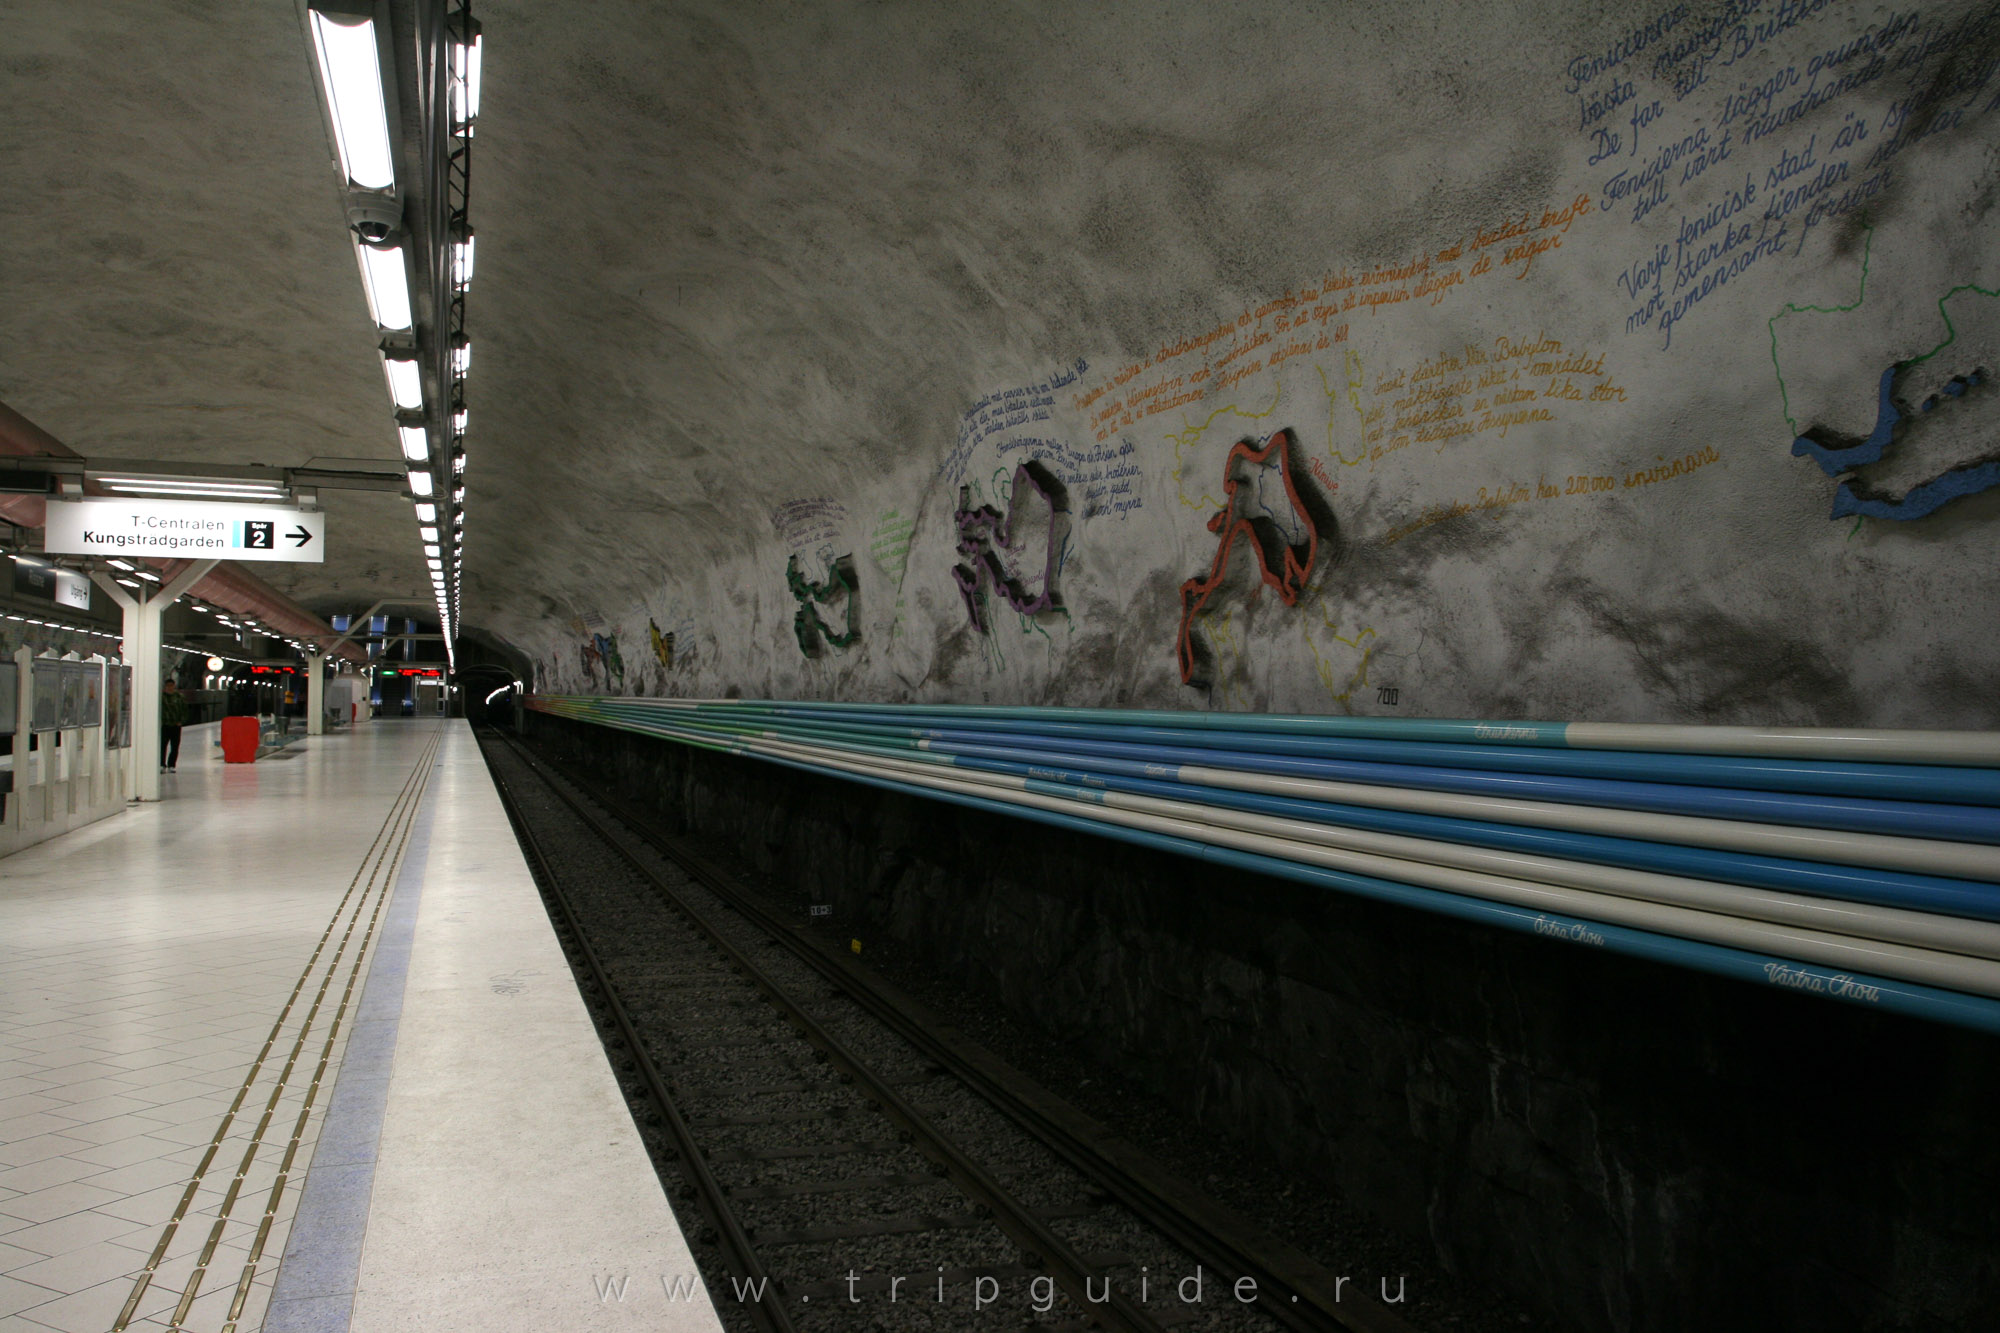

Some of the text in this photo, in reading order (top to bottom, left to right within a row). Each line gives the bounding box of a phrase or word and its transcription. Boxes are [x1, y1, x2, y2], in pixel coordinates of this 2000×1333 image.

[1601, 12, 1919, 211] Fenicierna lägger grunden
[1589, 128, 1622, 166] De
[1630, 101, 1664, 157] far
[1617, 241, 1671, 299] Varje
[1675, 172, 1757, 270] fenicisk
[1763, 134, 1817, 193] stad
[1830, 111, 1868, 153] är
[1631, 172, 1669, 224] till
[1469, 253, 1492, 277] de
[1625, 284, 1666, 334] mot
[1672, 224, 1751, 295] starka
[1757, 158, 1850, 242] fiender
[1658, 219, 1788, 351] gemensamt
[1494, 331, 1563, 370] Babylon
[1529, 352, 1606, 377] området
[1543, 376, 1583, 401] lika
[1589, 376, 1628, 402] stor
[1475, 482, 1531, 520] Babylon
[1536, 473, 1561, 500] har
[1623, 445, 1720, 488] invånare
[131, 515, 225, 530] T-Centralen
[253, 531, 266, 547] 2
[1376, 687, 1398, 705] 700
[1570, 923, 1604, 946] Chou
[1763, 961, 1880, 1002] Västra Chou
